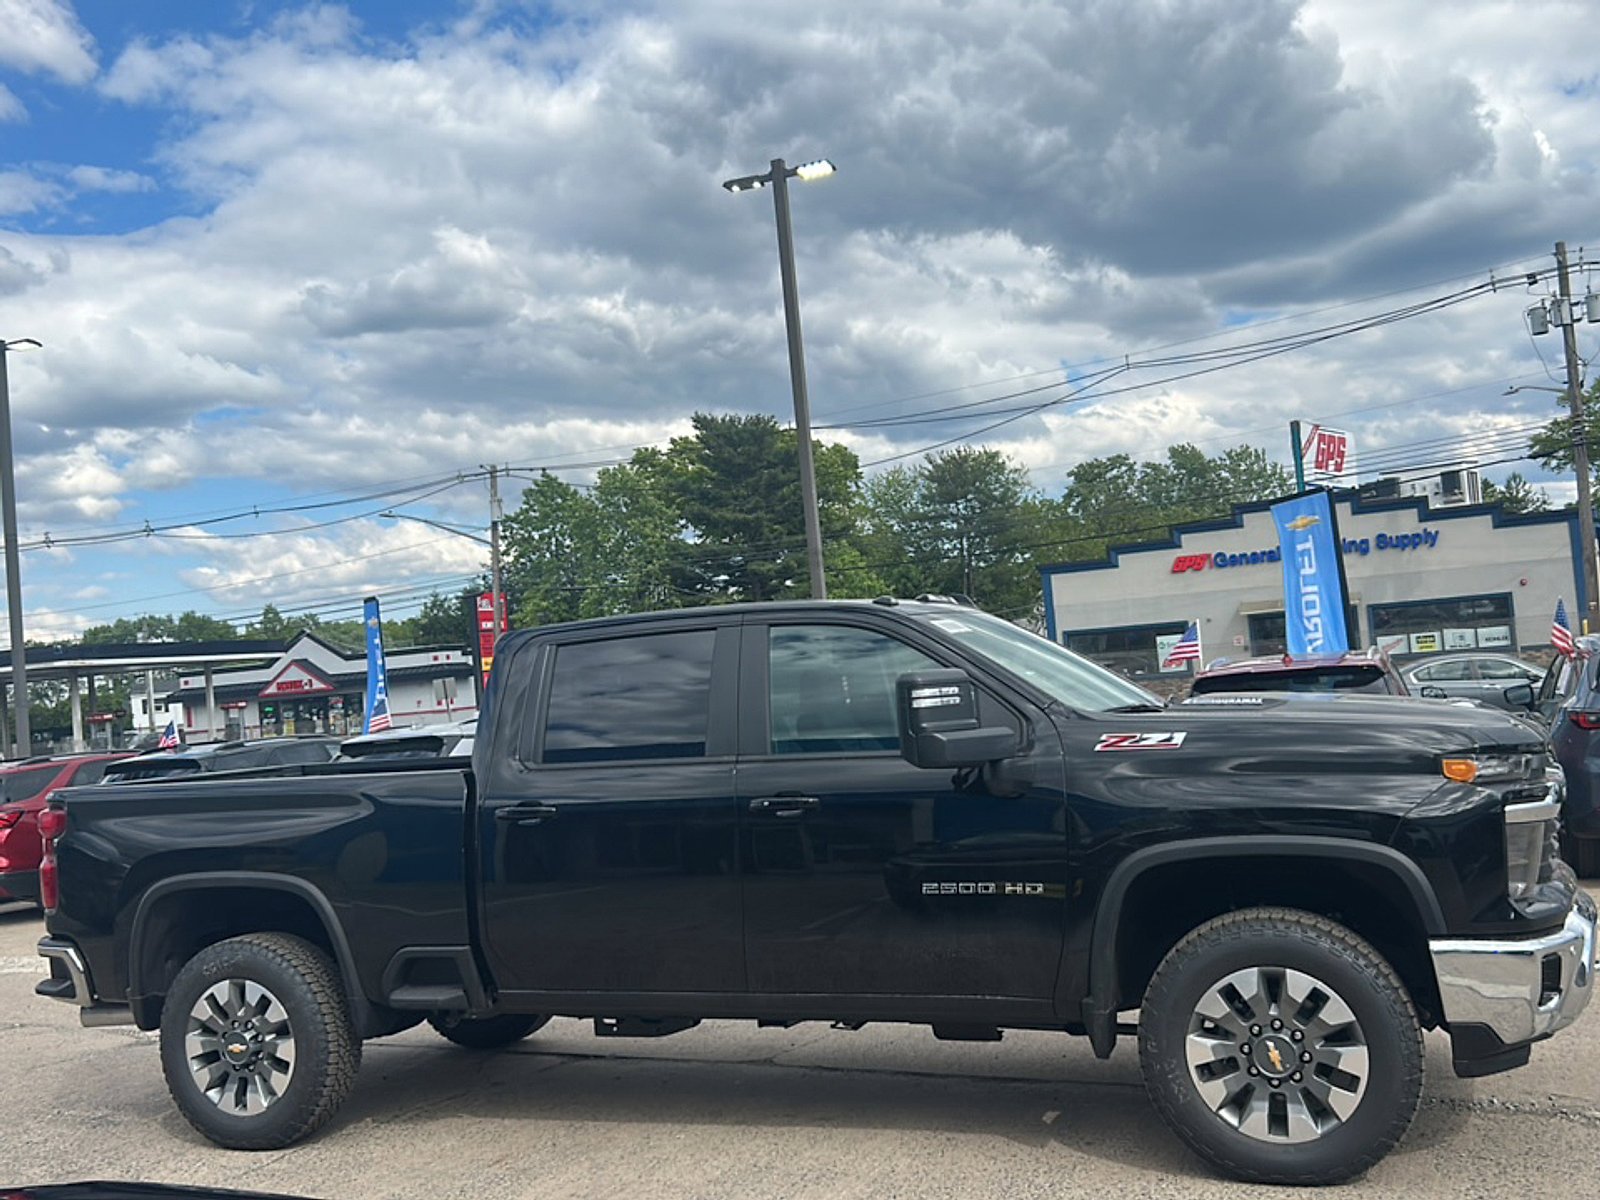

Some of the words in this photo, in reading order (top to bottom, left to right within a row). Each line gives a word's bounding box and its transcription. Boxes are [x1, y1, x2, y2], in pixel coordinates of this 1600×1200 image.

[1315, 433, 1346, 473] GPS
[1172, 554, 1209, 573] GPS
[1376, 528, 1439, 551] Supply
[1094, 732, 1187, 751] Z71
[922, 883, 996, 895] 2500
[1005, 883, 1044, 895] HD
